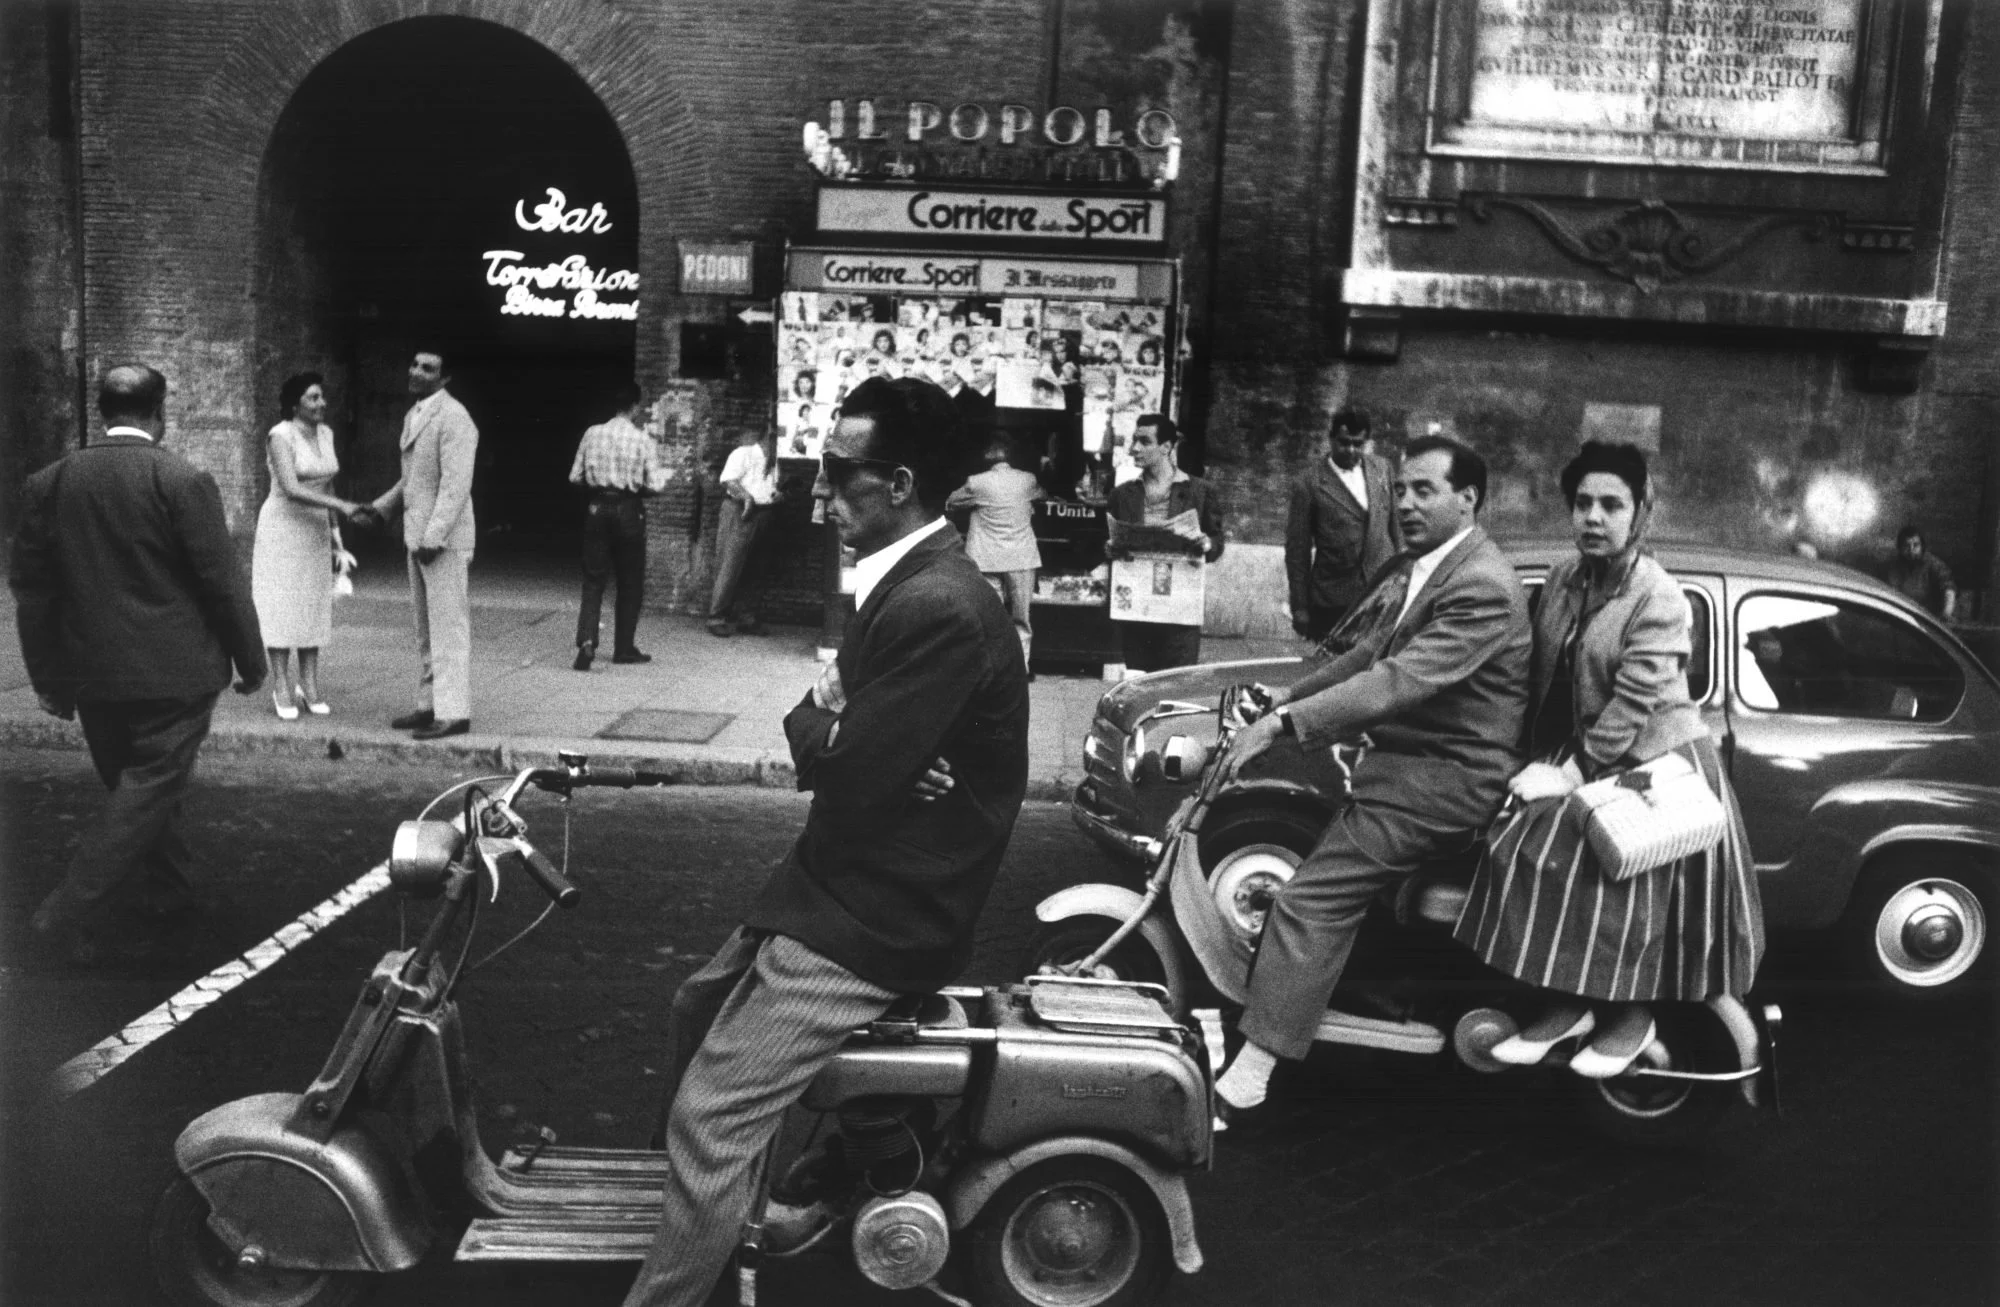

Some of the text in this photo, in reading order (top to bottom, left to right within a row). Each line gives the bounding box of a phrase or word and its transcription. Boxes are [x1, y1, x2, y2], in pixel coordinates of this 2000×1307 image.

[1763, 10, 1819, 25] LIGNIS
[1680, 65, 1742, 85] CARD
[829, 99, 1177, 149] IL POPOLO
[514, 186, 613, 235] Bar
[908, 191, 1038, 232] Corriere
[1064, 198, 1152, 239] Sport
[683, 253, 749, 281] PEDONI
[824, 260, 980, 290] Corriere Sport
